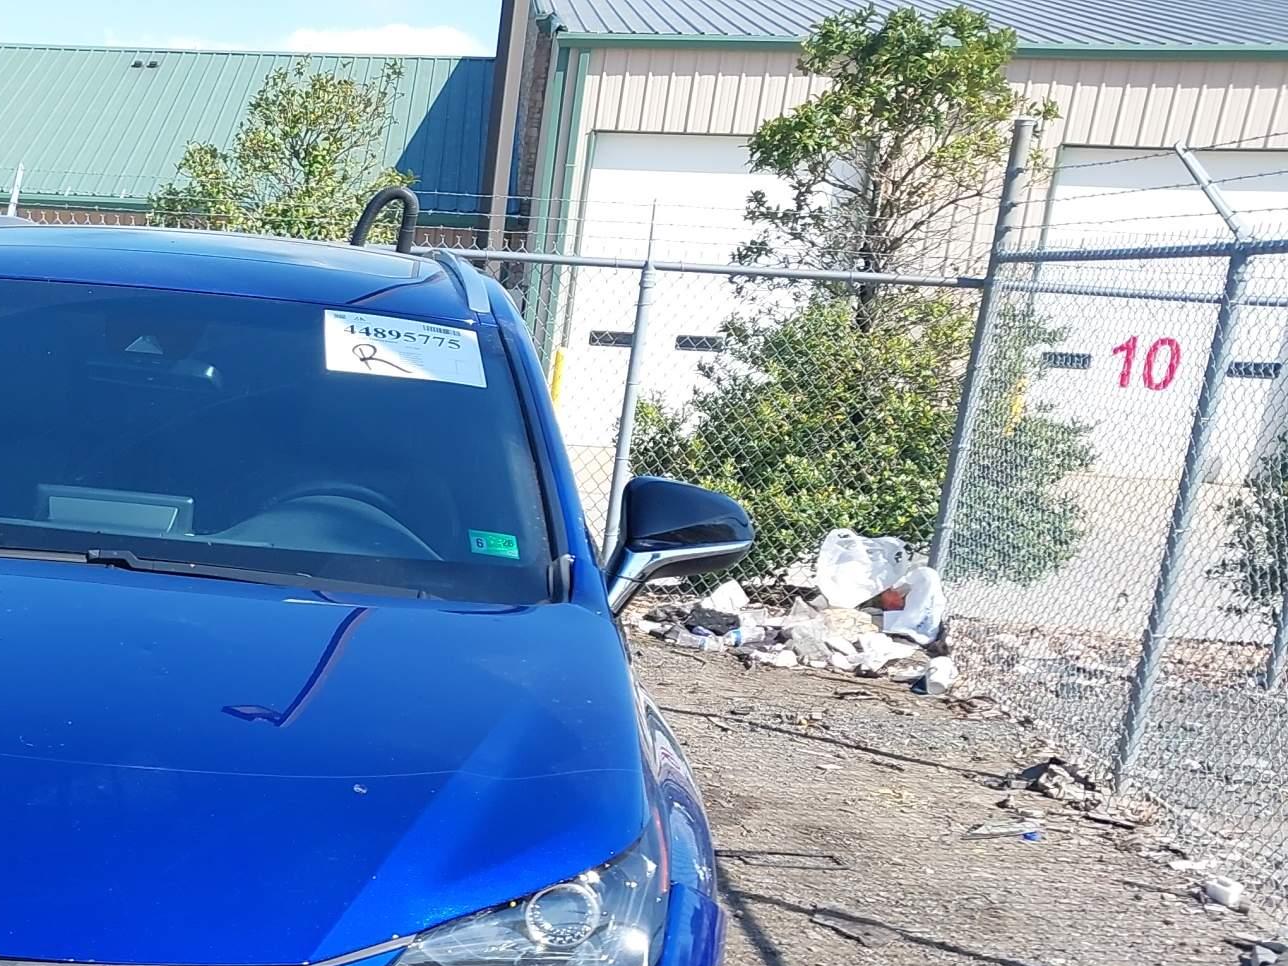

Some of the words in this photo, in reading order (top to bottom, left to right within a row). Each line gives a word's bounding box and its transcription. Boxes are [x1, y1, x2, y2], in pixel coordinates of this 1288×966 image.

[344, 324, 461, 350] 44895775
[1112, 335, 1181, 391] 10
[475, 537, 484, 549] 6
